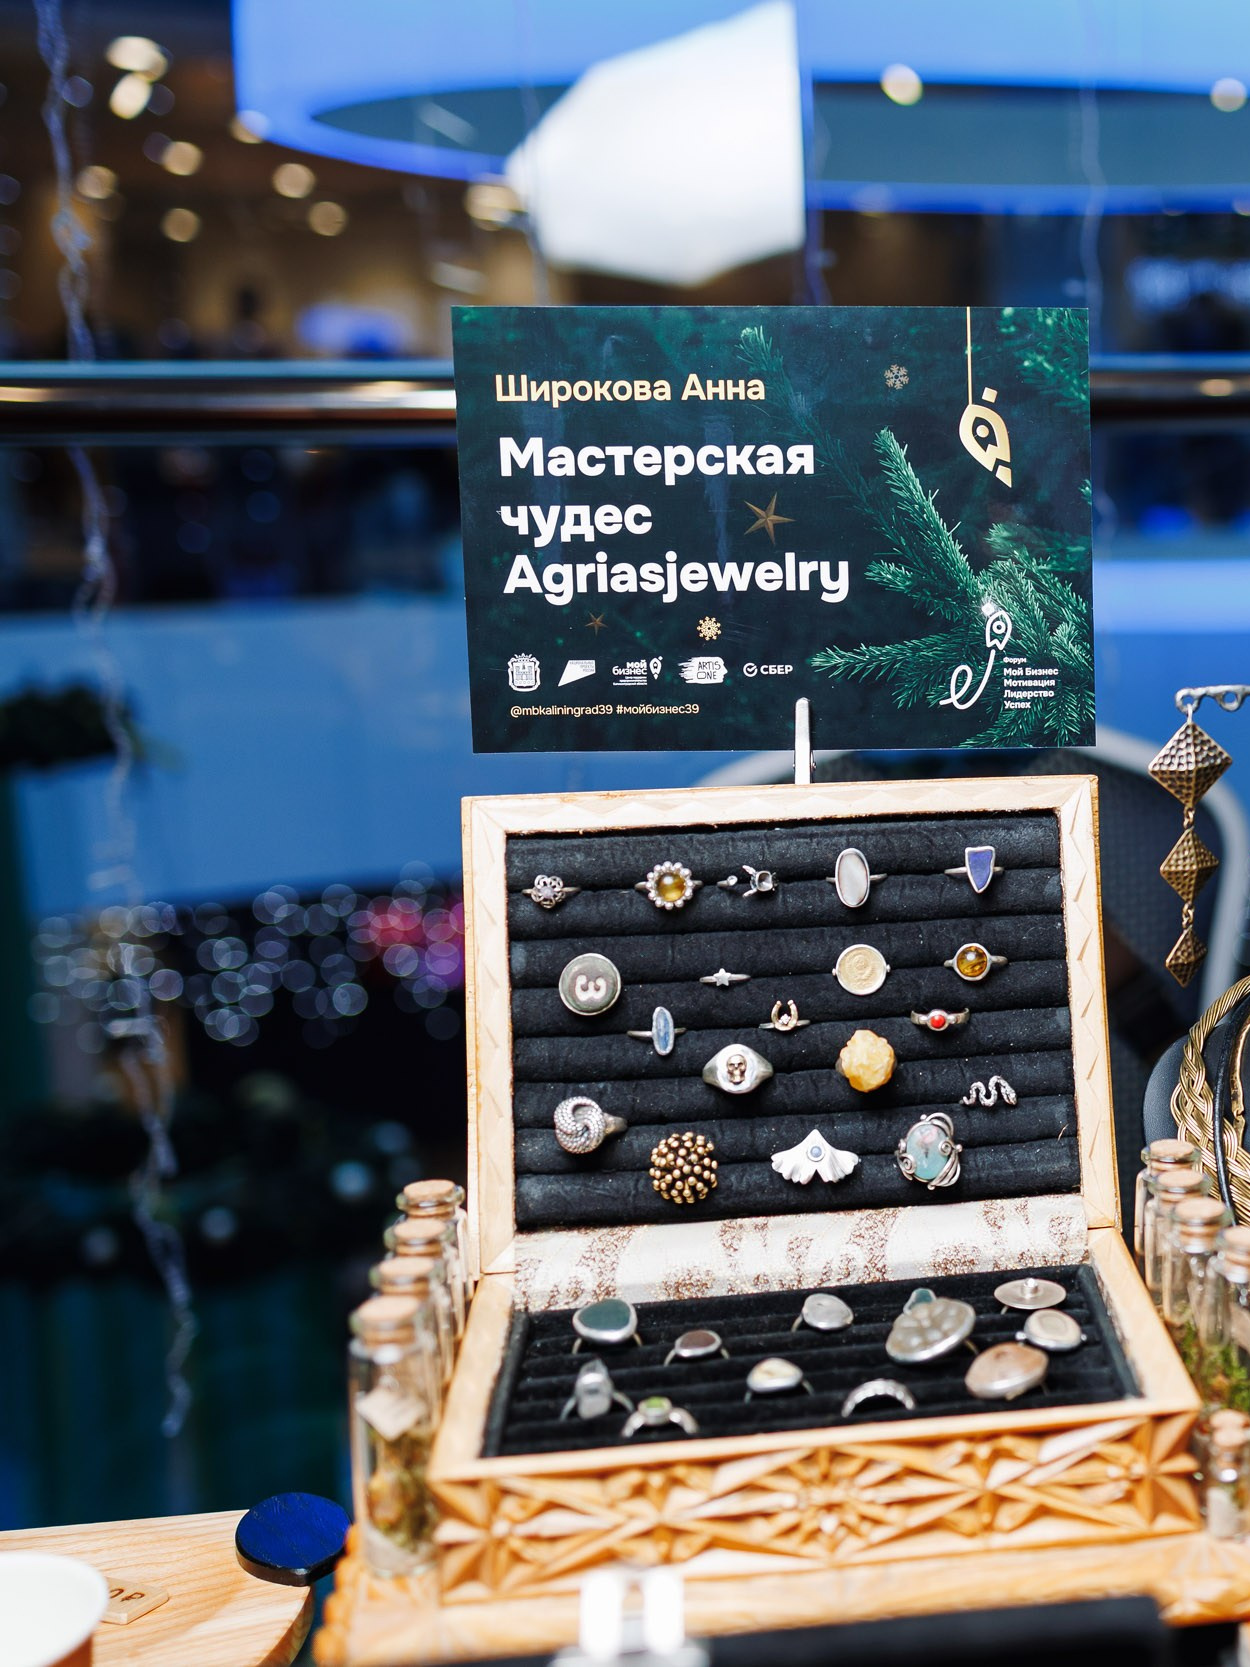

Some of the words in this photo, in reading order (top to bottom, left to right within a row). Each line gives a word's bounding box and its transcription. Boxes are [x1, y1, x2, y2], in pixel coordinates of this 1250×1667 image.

[495, 374, 672, 408] Широкова
[681, 373, 766, 401] Анна
[499, 436, 816, 486] Мастерская
[499, 503, 653, 548] чудес
[503, 550, 850, 606] Agriasjewelry
[626, 659, 648, 669] мой
[1003, 656, 1027, 664] Форум
[612, 665, 648, 676] бизнес
[697, 661, 721, 671] ARTIS
[760, 664, 794, 675] СБЕР
[696, 670, 718, 680] ONE
[1003, 667, 1024, 676] Мой
[1025, 667, 1059, 676] Бизнес
[1003, 679, 1056, 687] Мотивация
[1003, 689, 1055, 699] Лидерство
[616, 703, 700, 715] #мойбизнес39
[1003, 701, 1031, 709] Успех
[510, 704, 614, 718] @mbkaliningrad39
